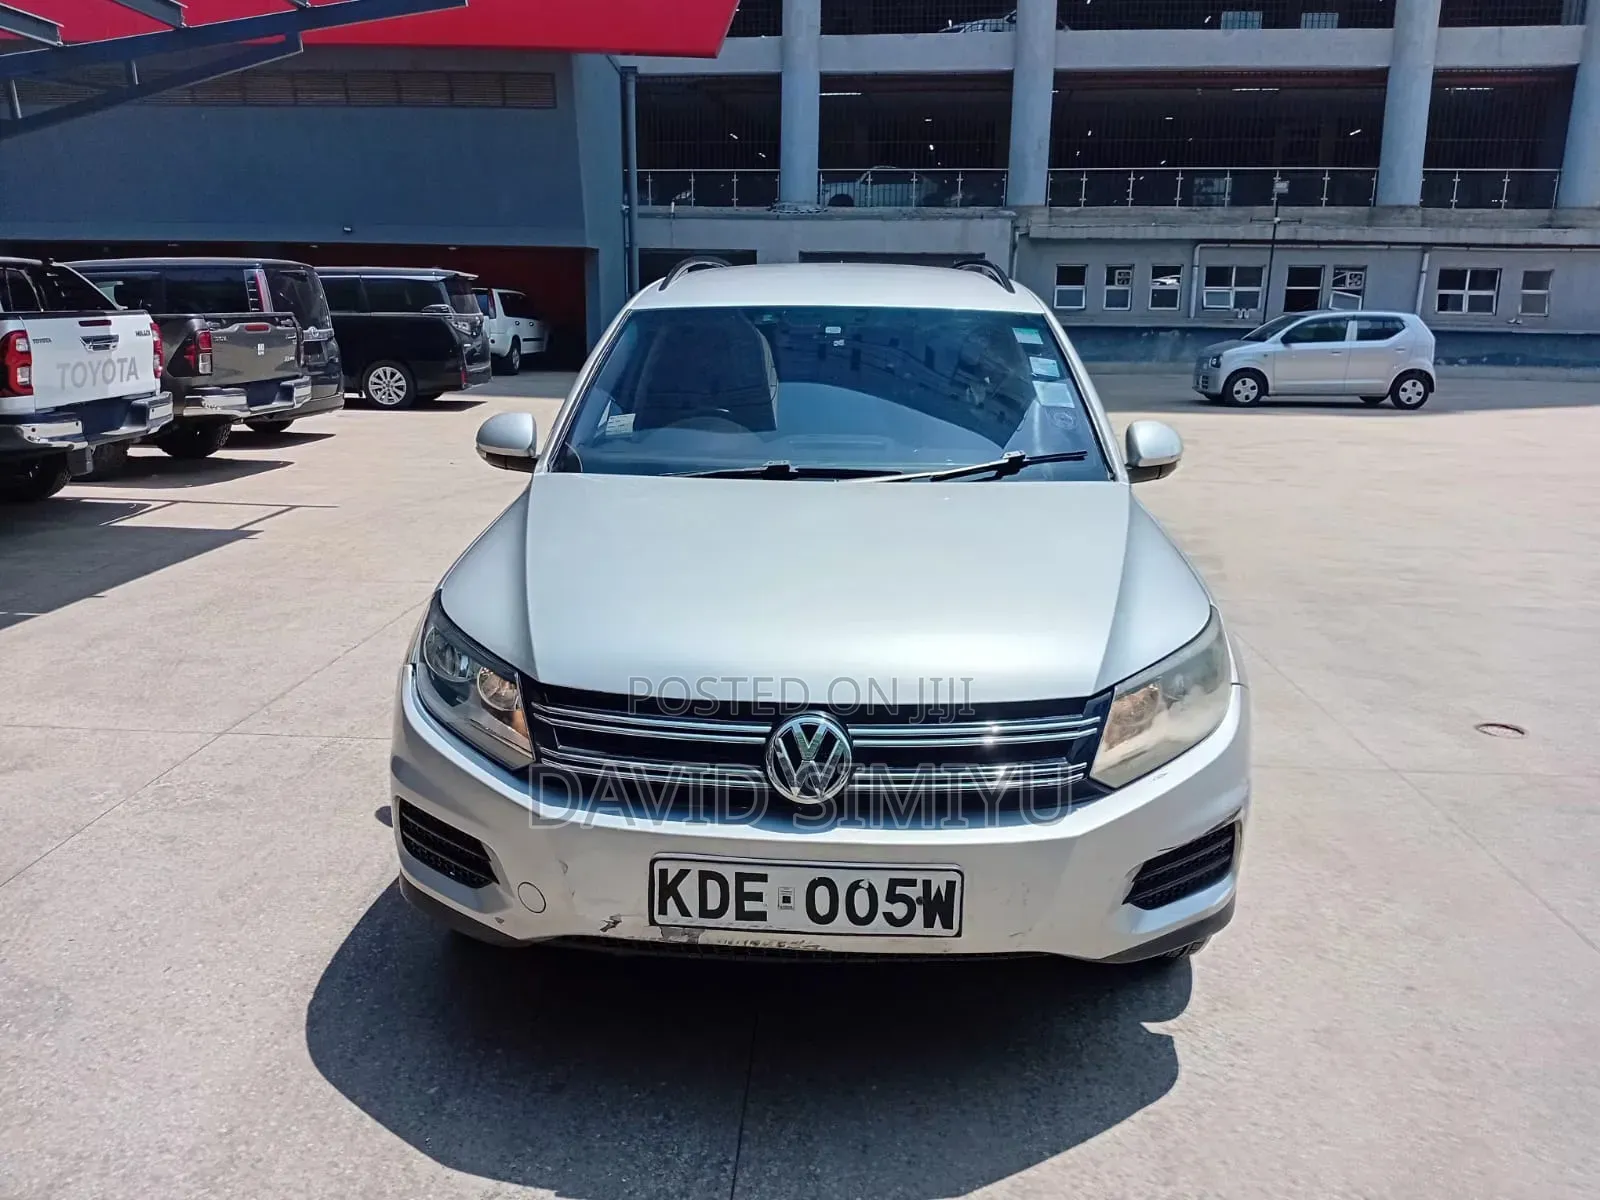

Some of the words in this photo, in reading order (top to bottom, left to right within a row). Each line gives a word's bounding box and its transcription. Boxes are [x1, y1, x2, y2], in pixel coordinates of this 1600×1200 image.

[56, 356, 140, 390] TOYOTA
[657, 868, 769, 922] KDE
[805, 876, 957, 930] 005W
